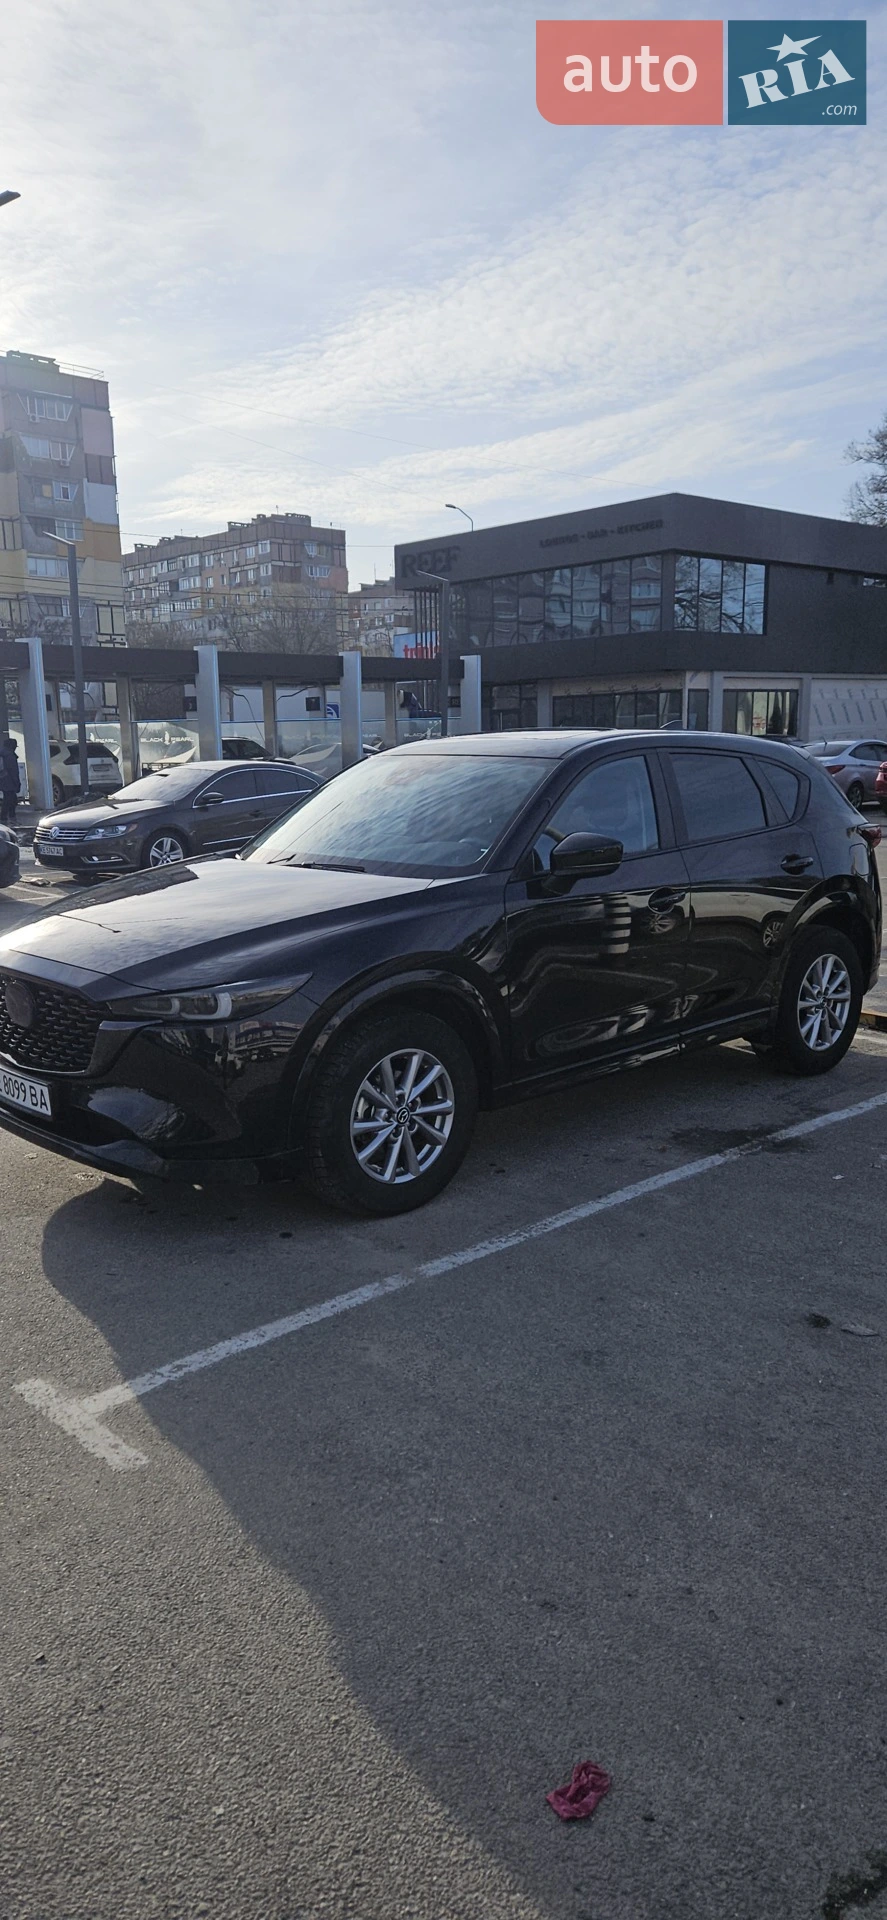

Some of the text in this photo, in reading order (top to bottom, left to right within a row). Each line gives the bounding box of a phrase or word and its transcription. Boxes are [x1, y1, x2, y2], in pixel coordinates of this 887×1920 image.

[400, 545, 461, 578] REEF
[3, 1074, 27, 1102] 8099
[29, 1084, 49, 1111] BA
